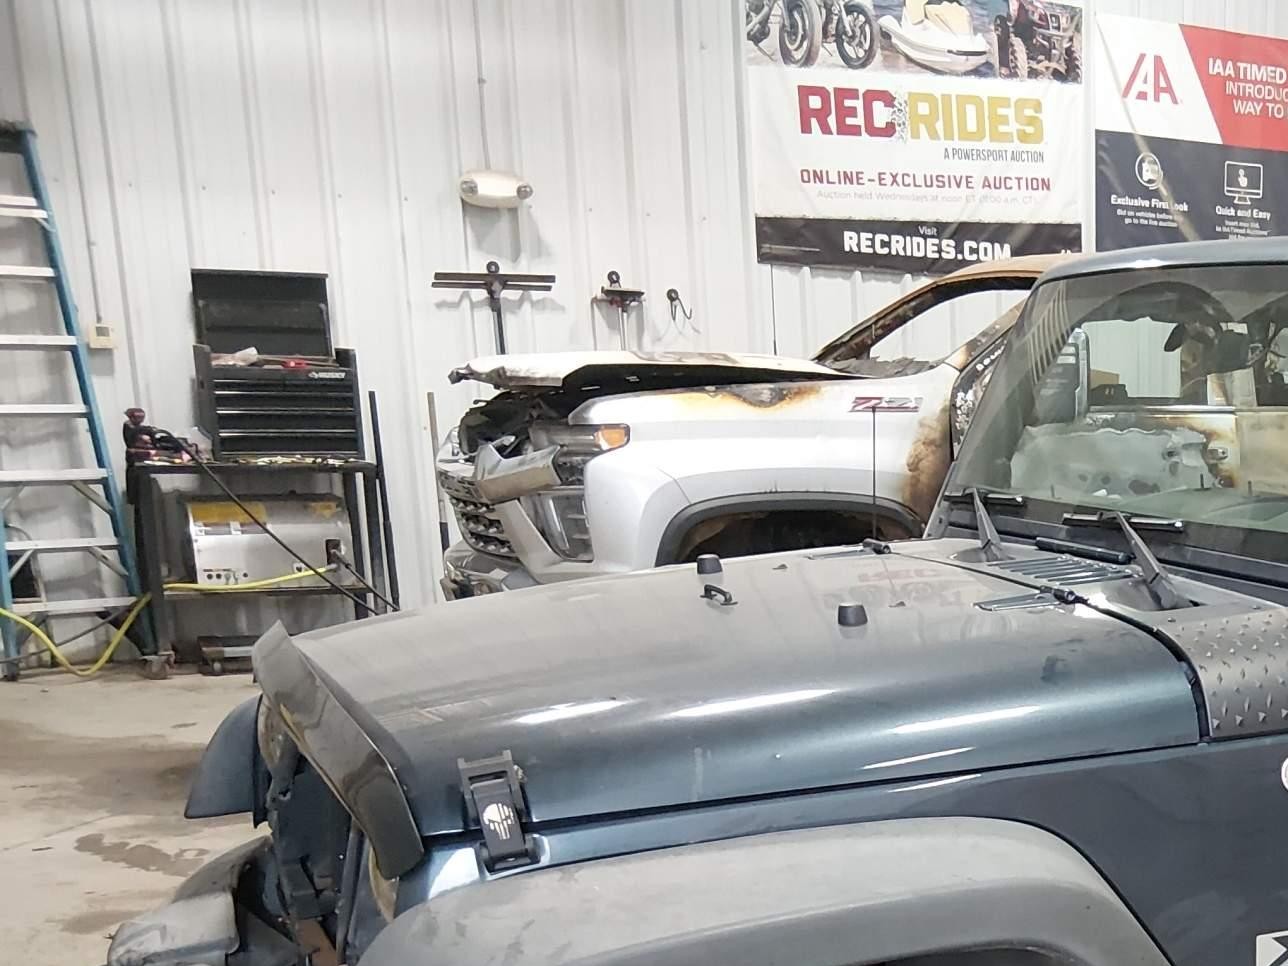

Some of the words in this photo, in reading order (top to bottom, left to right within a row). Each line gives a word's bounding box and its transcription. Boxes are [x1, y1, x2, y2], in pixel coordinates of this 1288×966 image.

[1208, 57, 1235, 79] IAA
[1237, 62, 1287, 84] TIMED
[907, 91, 1045, 145] RIDES
[1233, 99, 1263, 116] WAY
[1266, 102, 1284, 119] TO
[944, 147, 950, 160] A
[952, 148, 1008, 162] POWERSPORT
[1011, 151, 1044, 164] AUCTION
[800, 168, 975, 190] ONLINE-EXCLUSIVE
[981, 176, 1052, 191] AUCTION
[918, 225, 938, 236] Visit
[843, 230, 1012, 262] RECRIDES.COM
